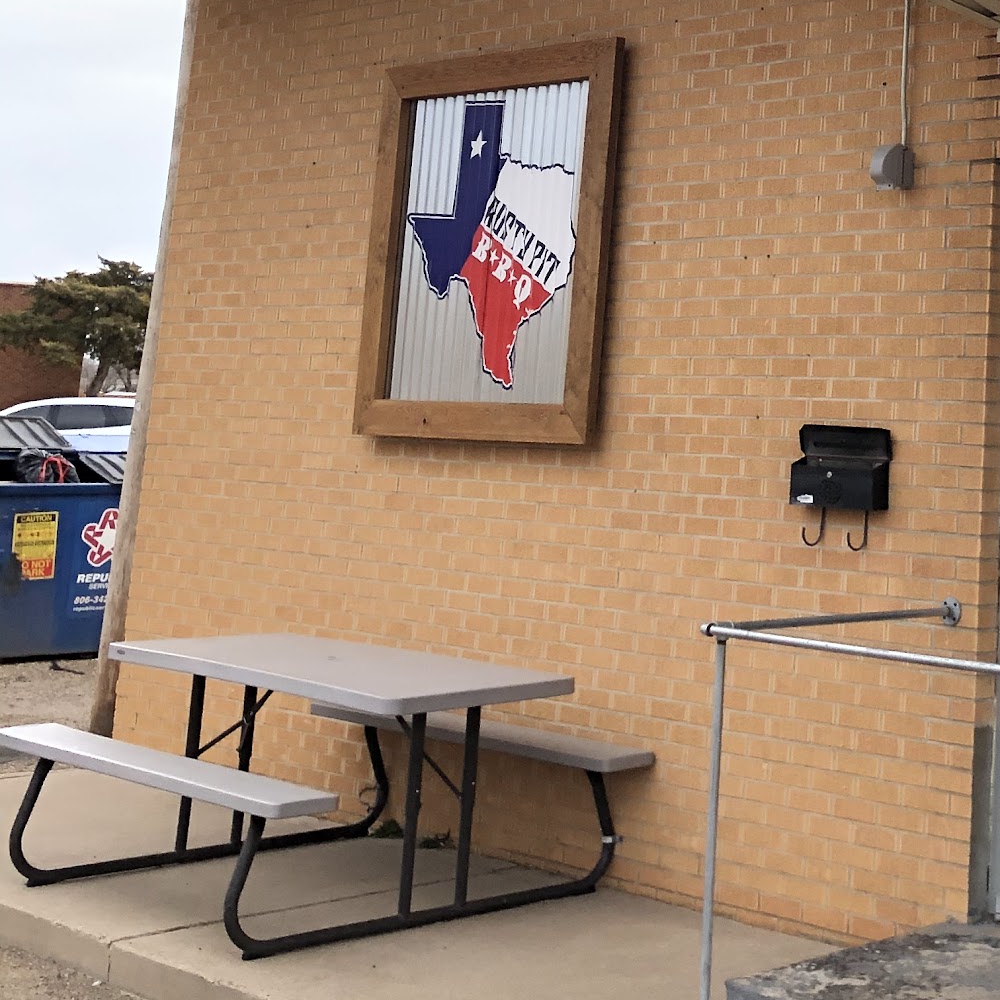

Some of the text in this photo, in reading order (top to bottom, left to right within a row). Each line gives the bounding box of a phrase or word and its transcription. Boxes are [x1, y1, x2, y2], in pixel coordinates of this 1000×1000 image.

[483, 195, 562, 286] RUSTY PIT
[20, 514, 53, 524] CAUTION
[31, 559, 51, 570] NOT
[76, 573, 110, 584] REPU
